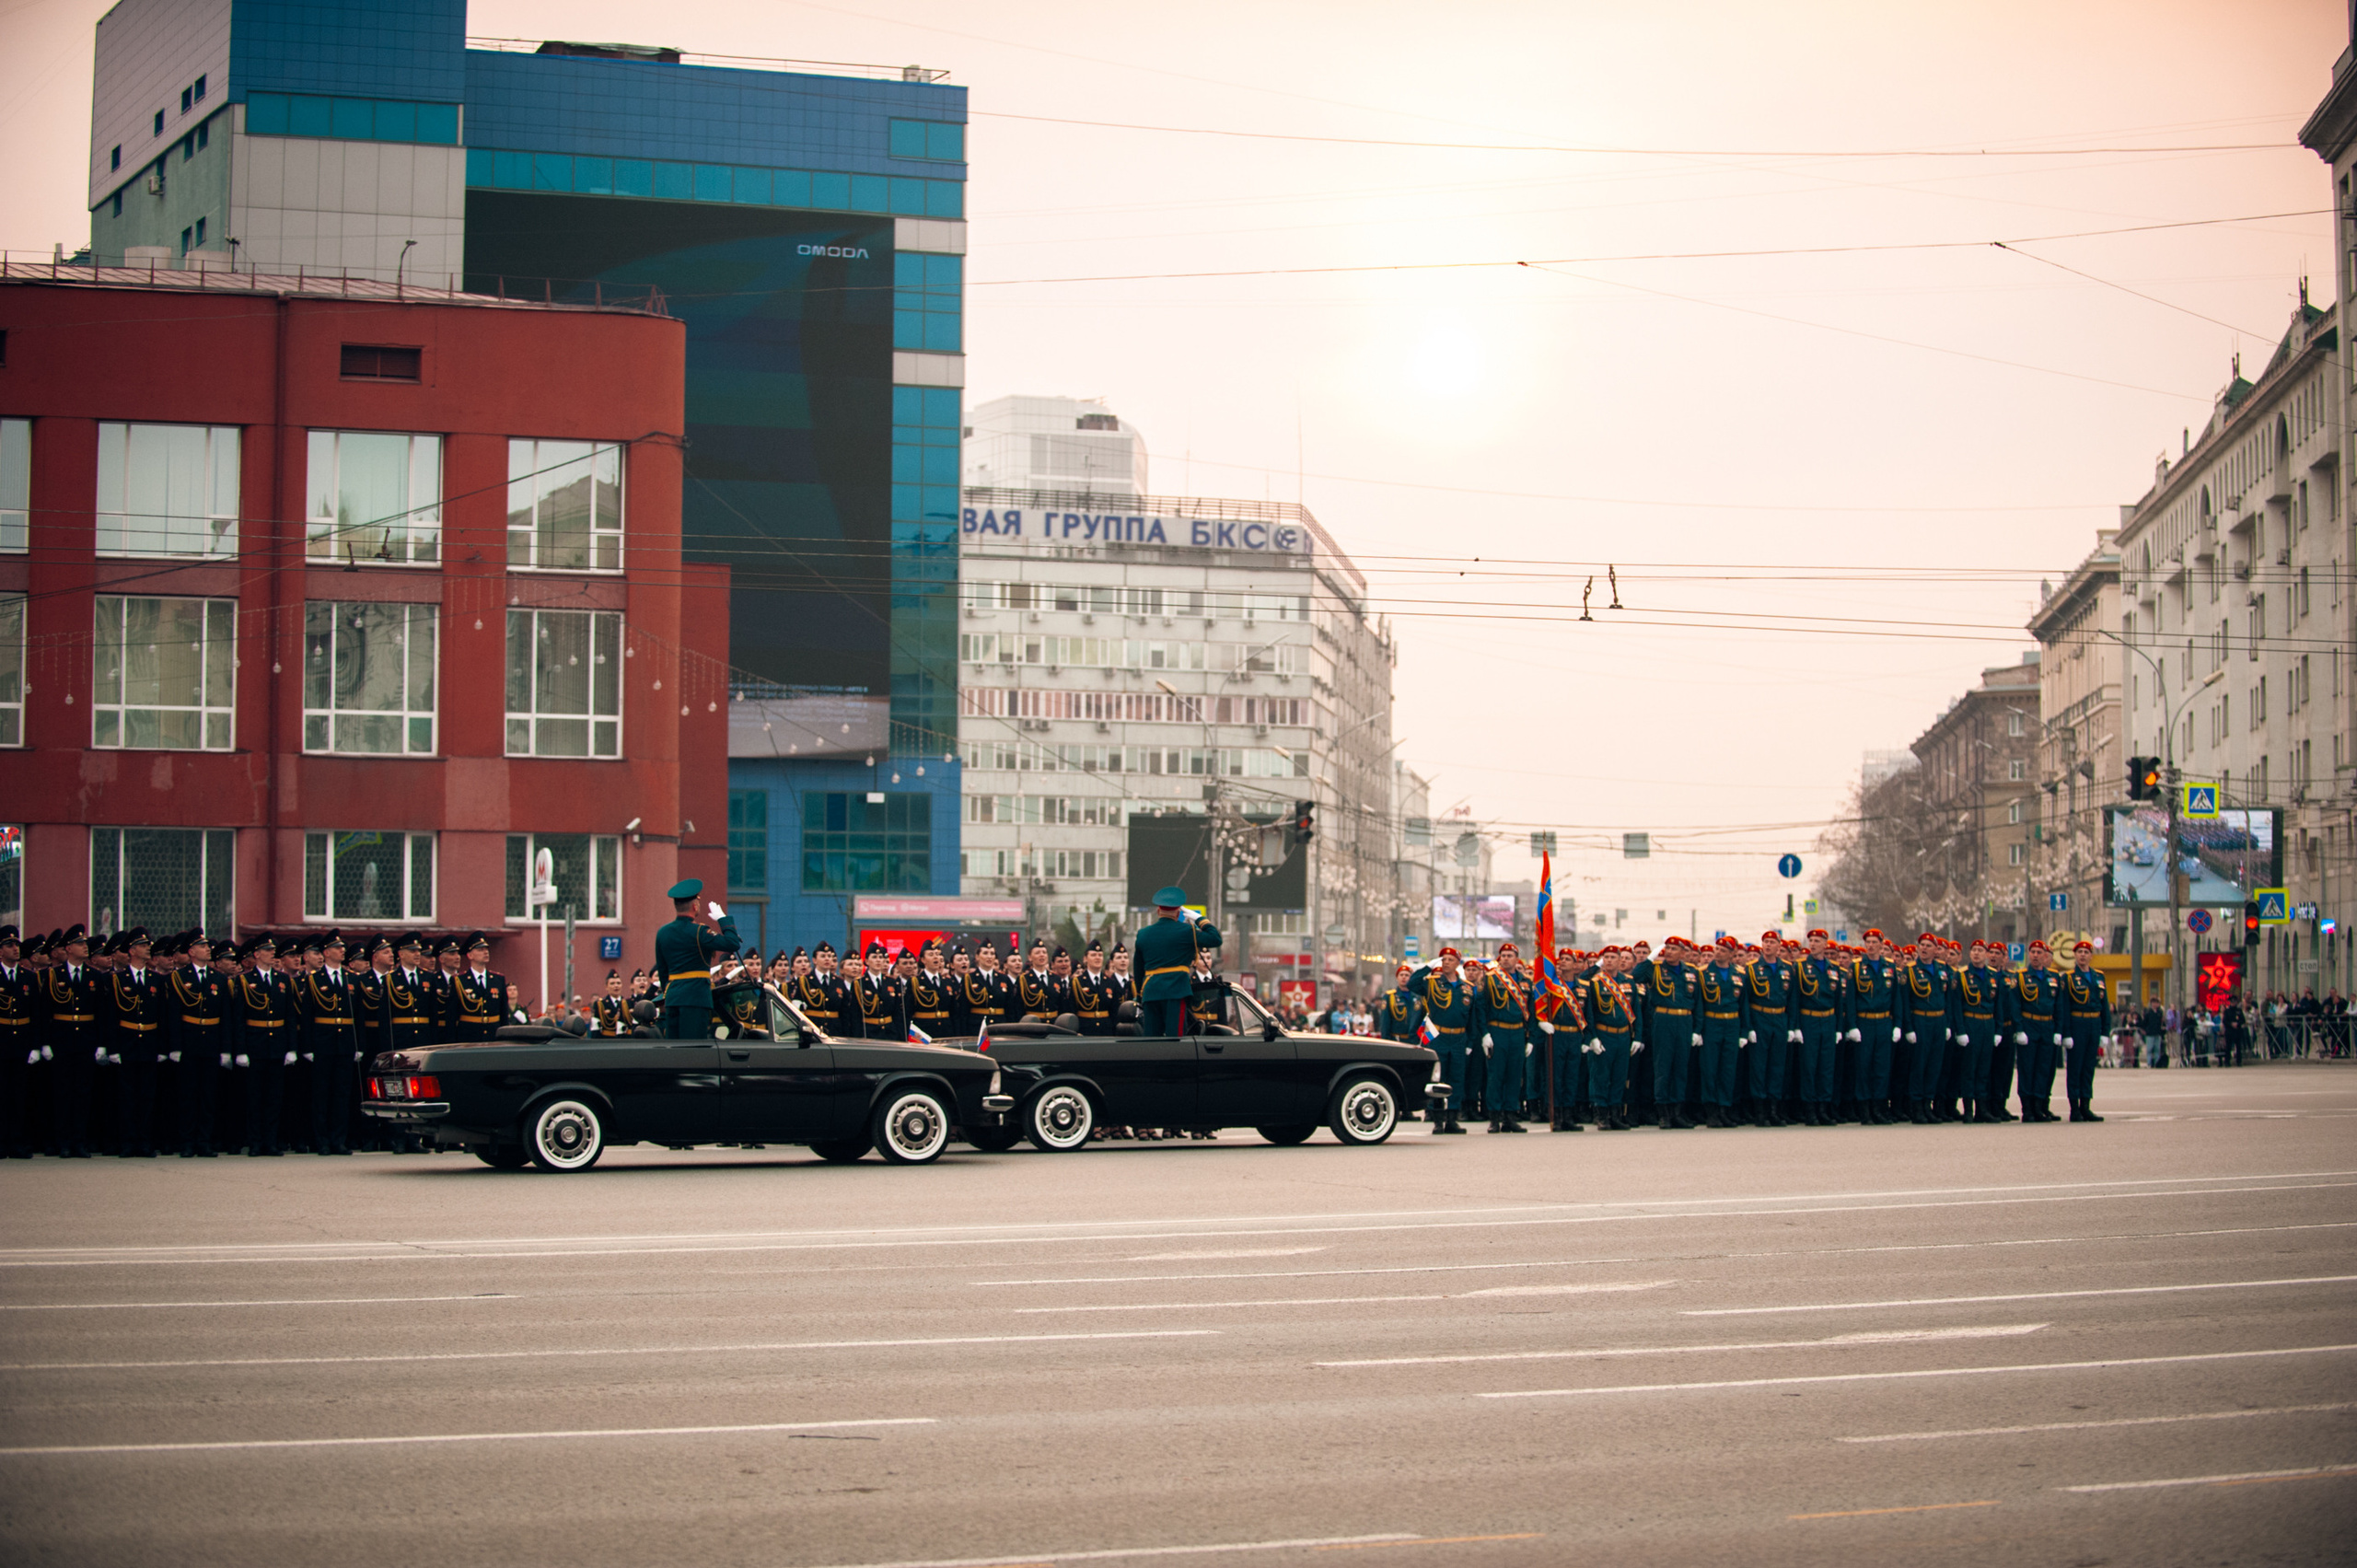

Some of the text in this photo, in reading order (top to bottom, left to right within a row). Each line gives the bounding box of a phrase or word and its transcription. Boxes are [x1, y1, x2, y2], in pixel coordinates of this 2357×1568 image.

[796, 244, 869, 259] OMODA
[963, 508, 1267, 550] ВАЯ ГРУППА БКС
[537, 861, 547, 881] М
[605, 938, 620, 950] 27
[2010, 945, 2021, 959] P
